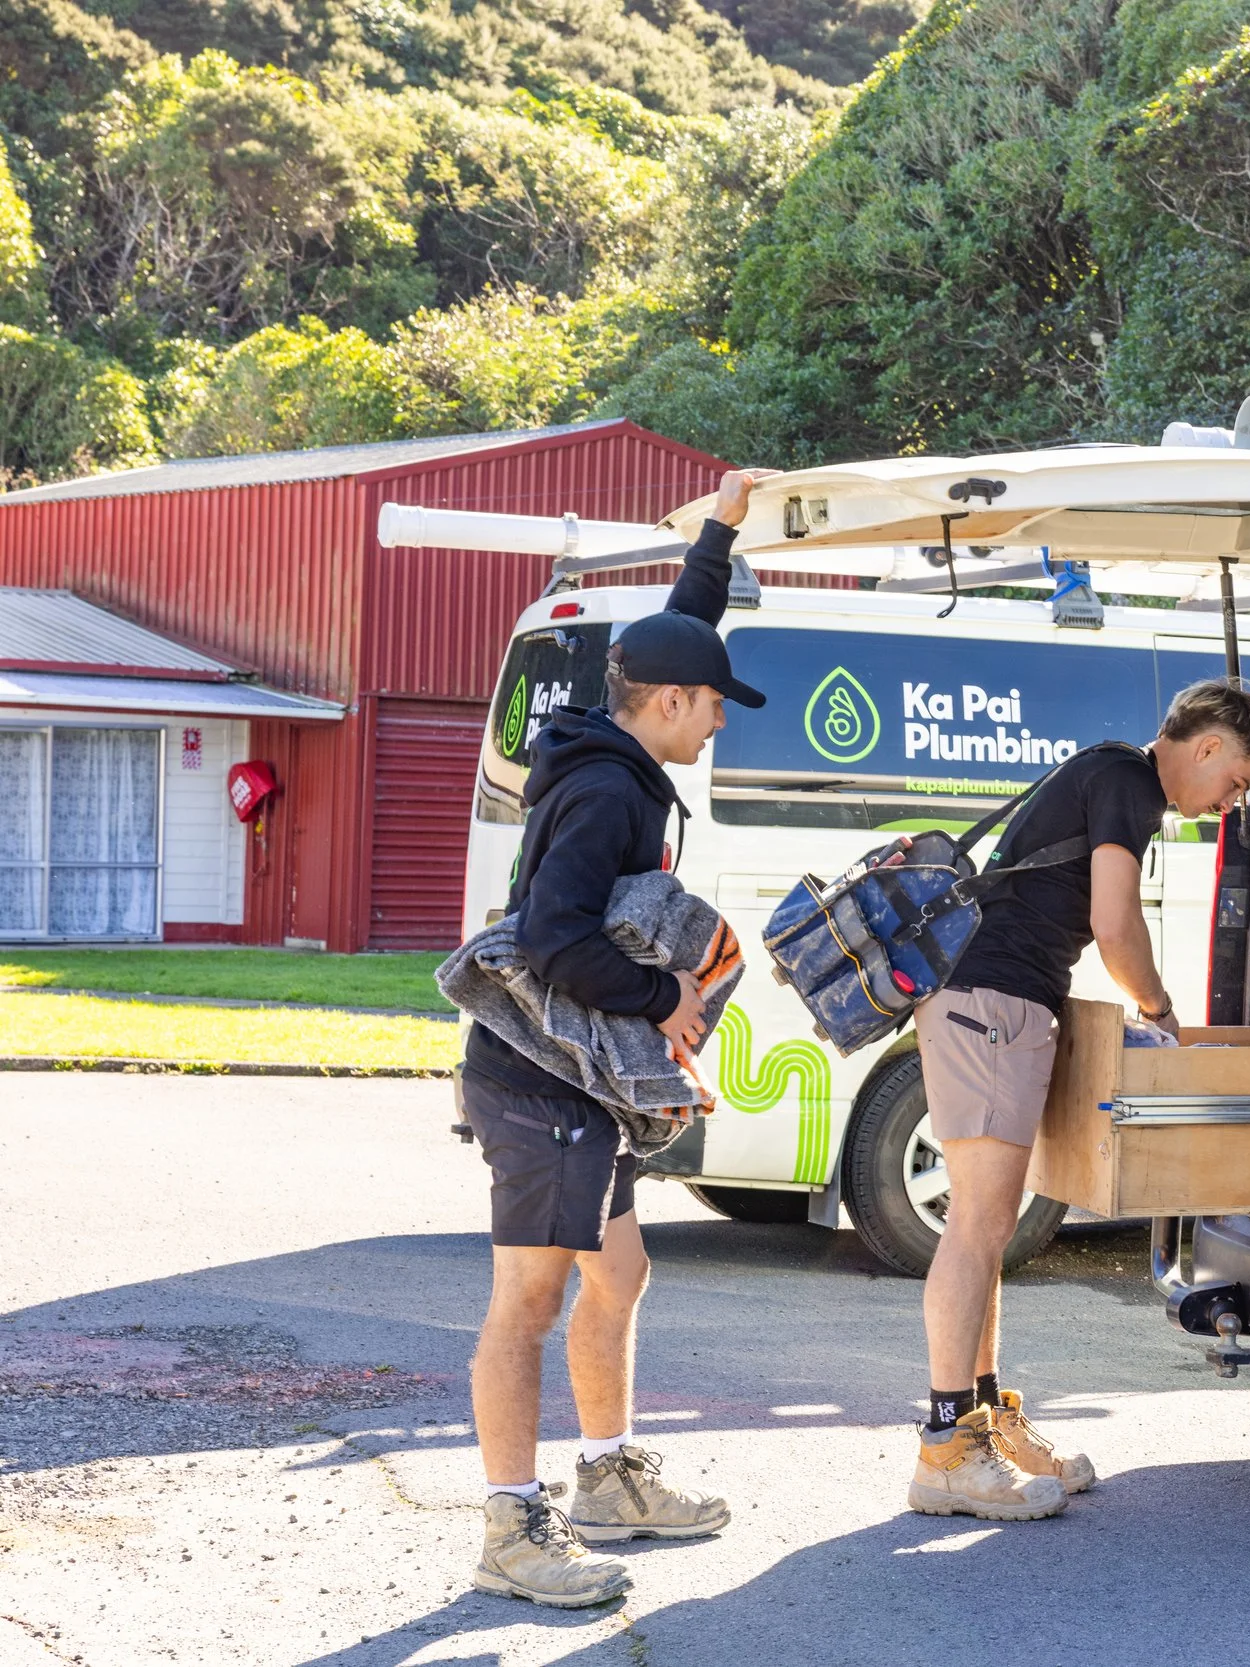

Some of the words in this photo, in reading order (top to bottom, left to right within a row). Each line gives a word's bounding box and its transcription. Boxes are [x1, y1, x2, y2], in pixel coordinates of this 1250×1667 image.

[530, 682, 549, 715] Ka
[902, 681, 954, 721] Ka
[962, 685, 1022, 723] Pai
